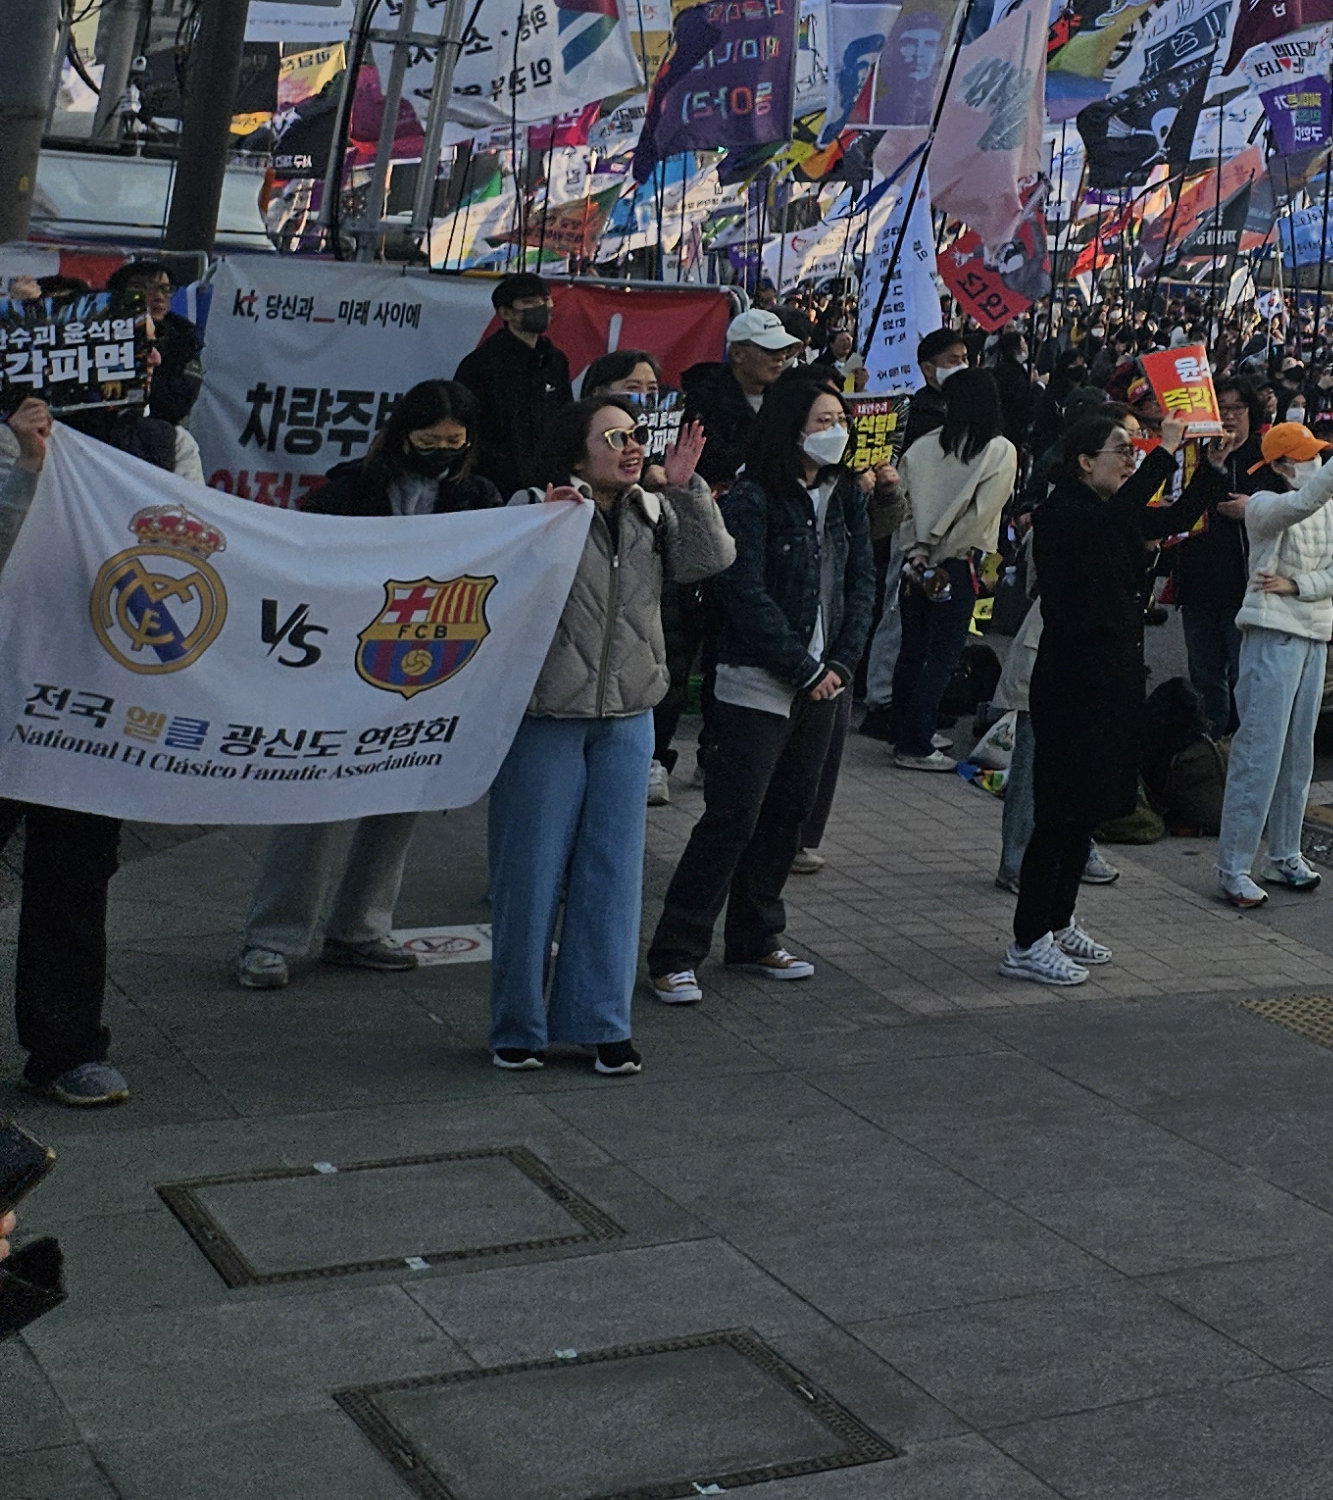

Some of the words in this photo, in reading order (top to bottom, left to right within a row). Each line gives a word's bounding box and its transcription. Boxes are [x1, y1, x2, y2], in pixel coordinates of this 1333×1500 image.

[62, 317, 136, 345] 윤석열
[0, 341, 136, 390] 각파면
[238, 381, 404, 455] 차량주
[261, 597, 330, 668] VS
[397, 624, 448, 639] FCB
[26, 681, 115, 729] 전국
[218, 723, 348, 759] 광신도
[354, 715, 460, 756] 연합회
[7, 722, 118, 761] National
[121, 743, 146, 766] El
[149, 751, 237, 781] Clásico
[243, 761, 328, 783] Fanatic
[331, 748, 443, 782] Association
